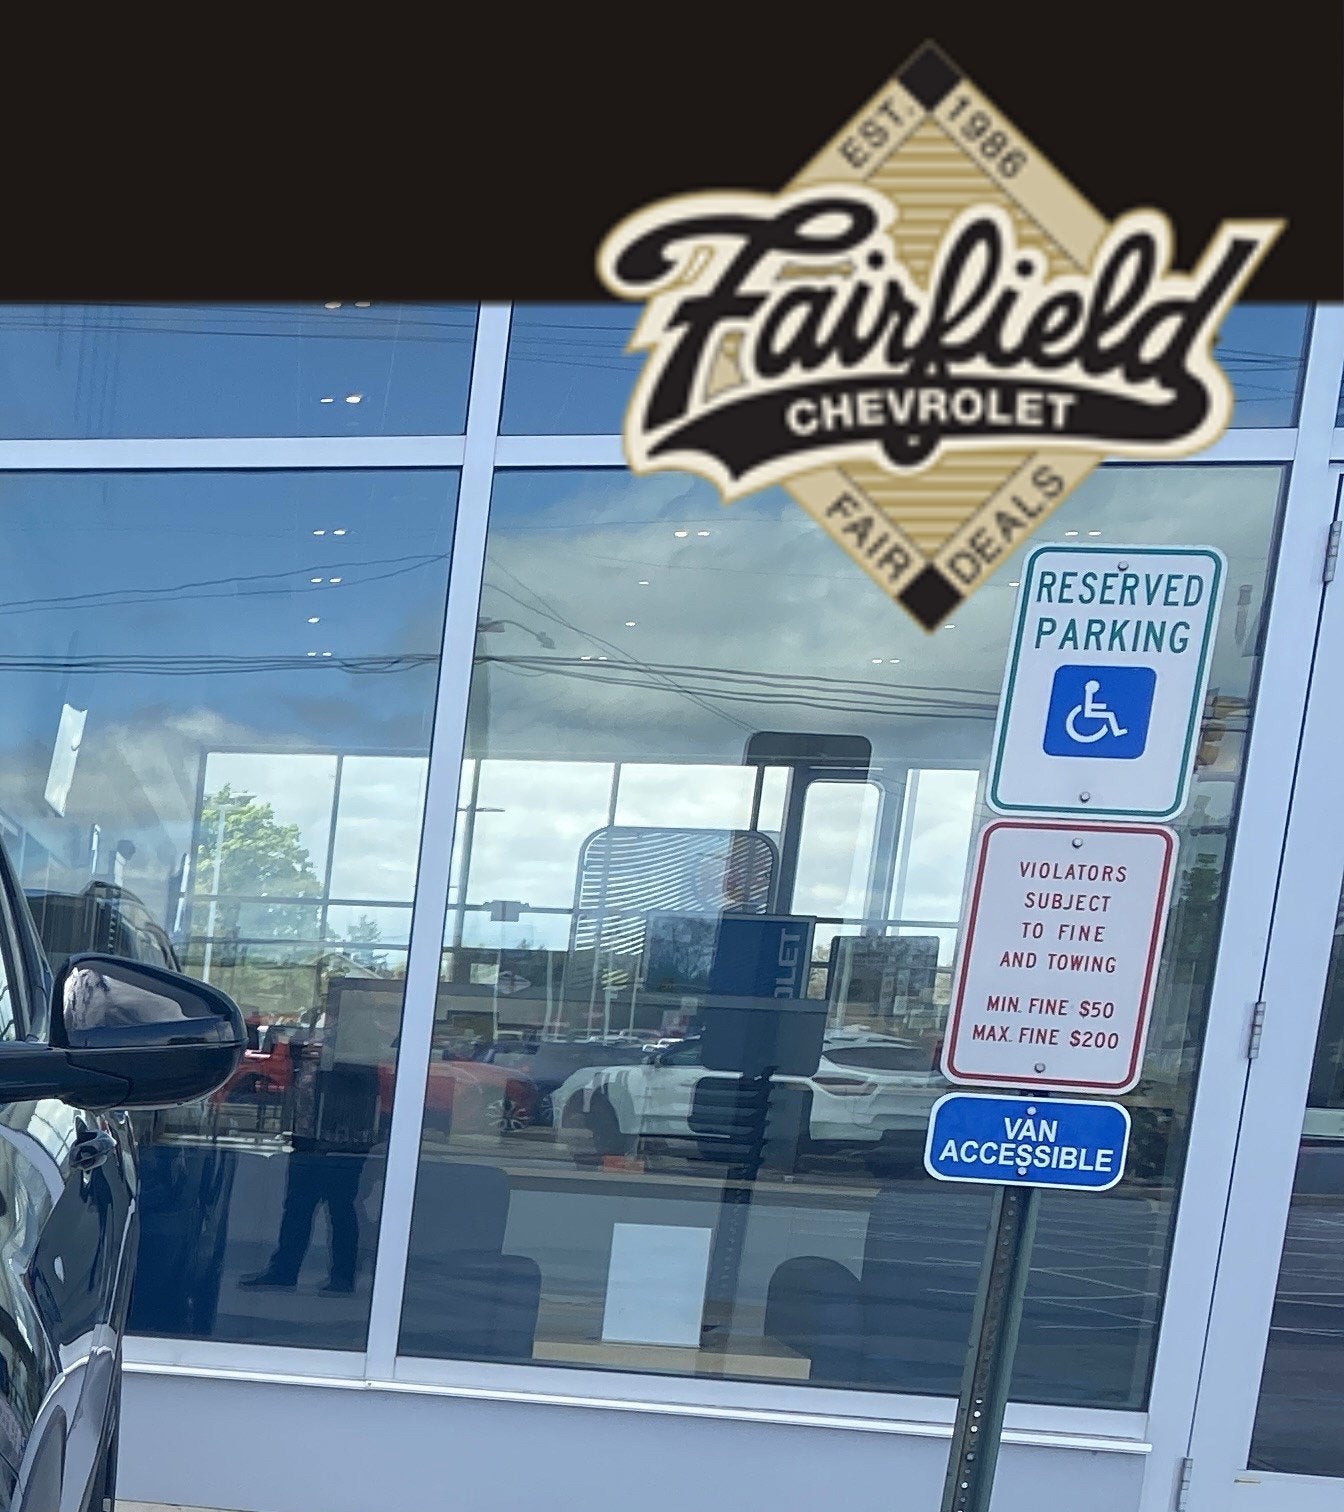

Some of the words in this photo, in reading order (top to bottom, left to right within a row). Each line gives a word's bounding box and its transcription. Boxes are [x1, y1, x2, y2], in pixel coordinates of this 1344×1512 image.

[1035, 570, 1205, 608] RESERVED
[1033, 617, 1192, 655] PARKING
[1018, 860, 1128, 884] VIOLATORS
[1023, 891, 1112, 914] SUBJECT
[1021, 921, 1044, 941] TO
[1057, 923, 1106, 943] FINE
[999, 951, 1038, 971] AND
[1046, 952, 1118, 976] TOWING
[986, 995, 1023, 1016] MIN.
[1028, 997, 1070, 1018] FINE
[1078, 998, 1116, 1020] $50
[972, 1024, 1014, 1045] MAX.
[1018, 1026, 1061, 1047] FINE
[1069, 1028, 1120, 1051] $200
[1003, 1117, 1059, 1143] VAN
[937, 1138, 1115, 1173] ACCESSIBLE
